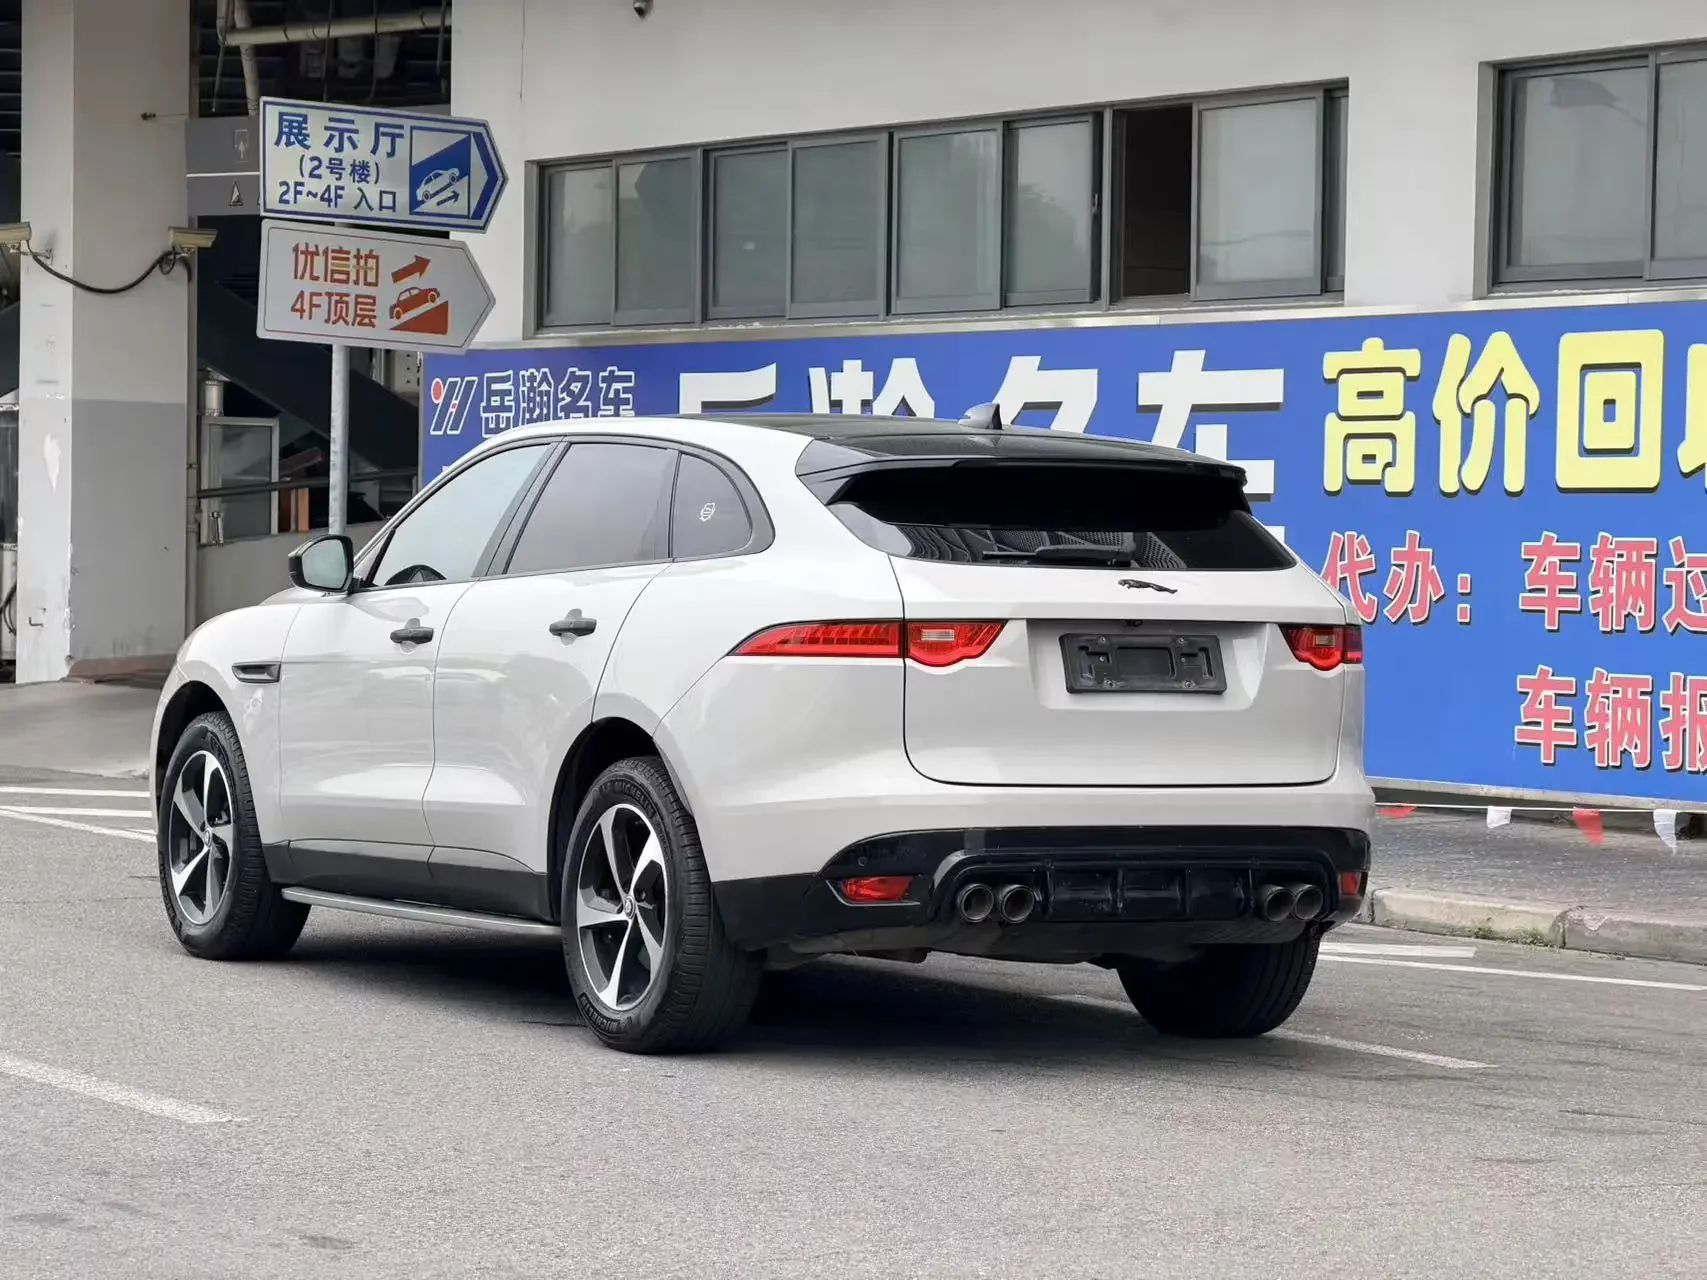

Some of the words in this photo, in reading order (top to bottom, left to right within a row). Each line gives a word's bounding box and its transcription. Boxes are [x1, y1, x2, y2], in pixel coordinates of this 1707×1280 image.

[274, 111, 405, 158] 展示厅
[299, 154, 381, 184] (2号楼)
[352, 190, 397, 212] 入口
[292, 242, 380, 287] 优信拍
[290, 290, 378, 328] 4F顶层
[1323, 329, 1707, 494] 高价回
